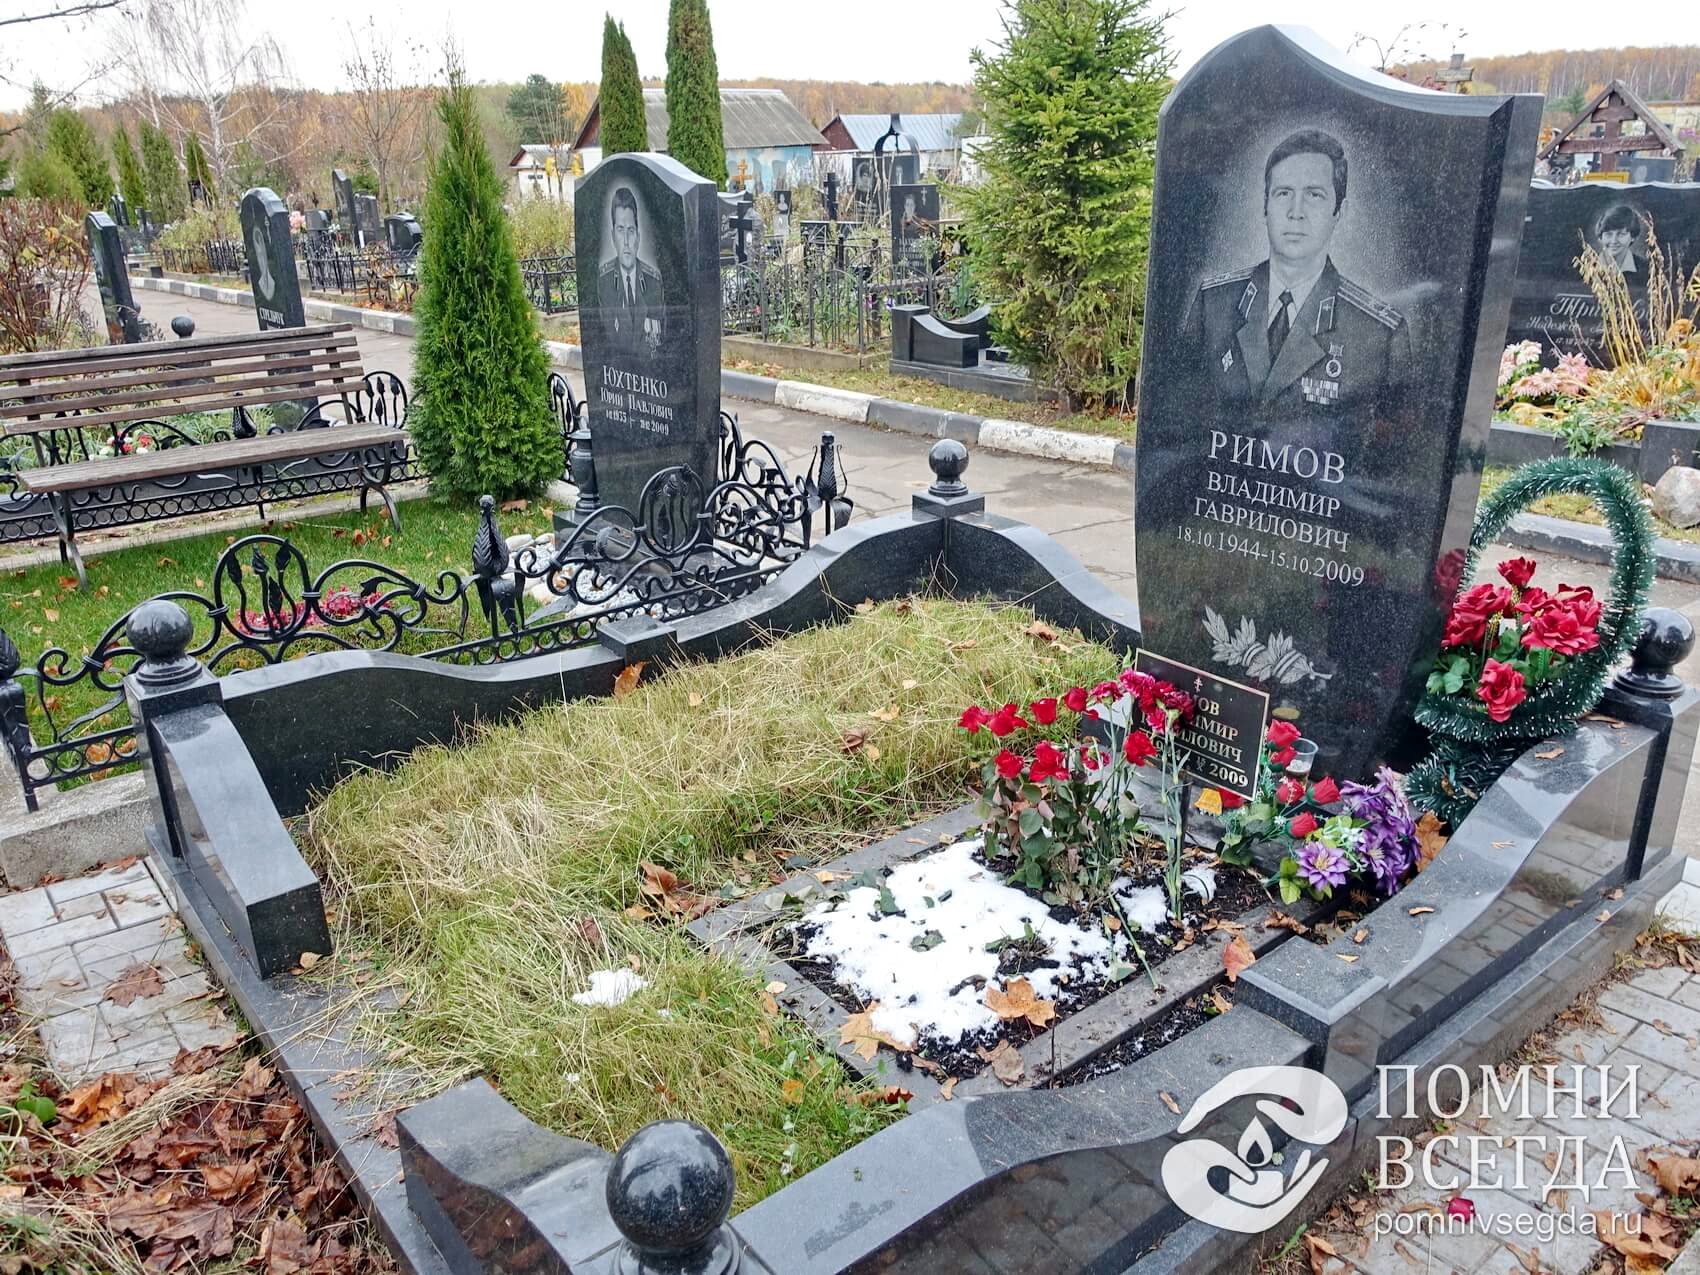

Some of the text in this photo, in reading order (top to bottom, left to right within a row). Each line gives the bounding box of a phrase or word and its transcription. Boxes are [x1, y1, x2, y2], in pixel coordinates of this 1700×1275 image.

[603, 365, 668, 399] ЮХТЕНКО
[1208, 429, 1345, 484] РИМОВ
[1207, 471, 1341, 518] ВЛАДИМИР
[1193, 497, 1350, 553] ГАВРИЛОВИЧ
[1209, 763, 1249, 788] 2009
